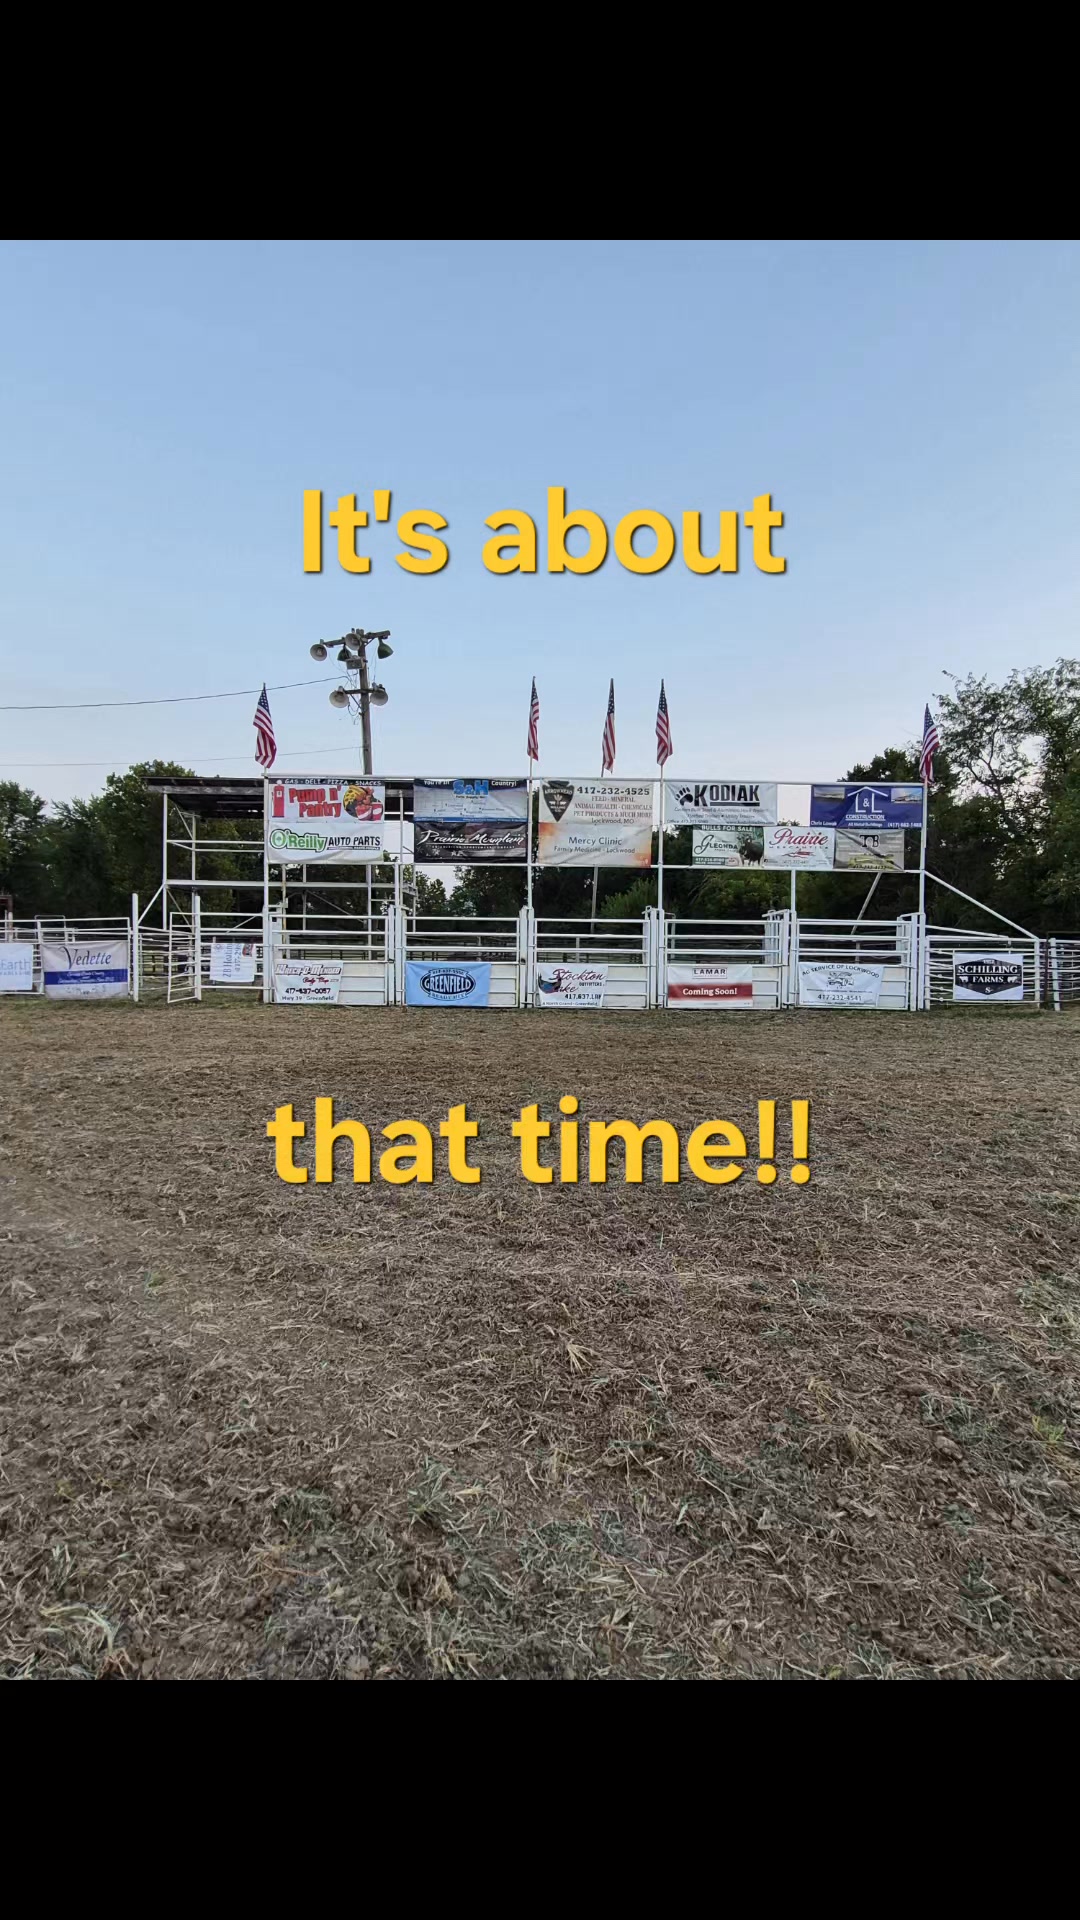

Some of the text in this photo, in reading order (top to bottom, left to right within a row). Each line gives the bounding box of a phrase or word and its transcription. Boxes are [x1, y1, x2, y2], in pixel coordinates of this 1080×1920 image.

[289, 788, 326, 803] Pump
[577, 787, 650, 796] 417-232-4525
[694, 785, 761, 807] KODIAK
[299, 802, 342, 818] Pantry
[270, 829, 381, 853] O'Reilly AUTO PARTS
[568, 837, 623, 846] Mercy Clinic
[769, 828, 829, 846] Prairie
[58, 946, 112, 970] Vedette
[549, 969, 605, 981] Stockton
[811, 965, 835, 973] SERVICE
[846, 965, 880, 979] LOCKWOOD
[424, 975, 472, 993] GREENFIELD
[682, 988, 714, 997] Coming
